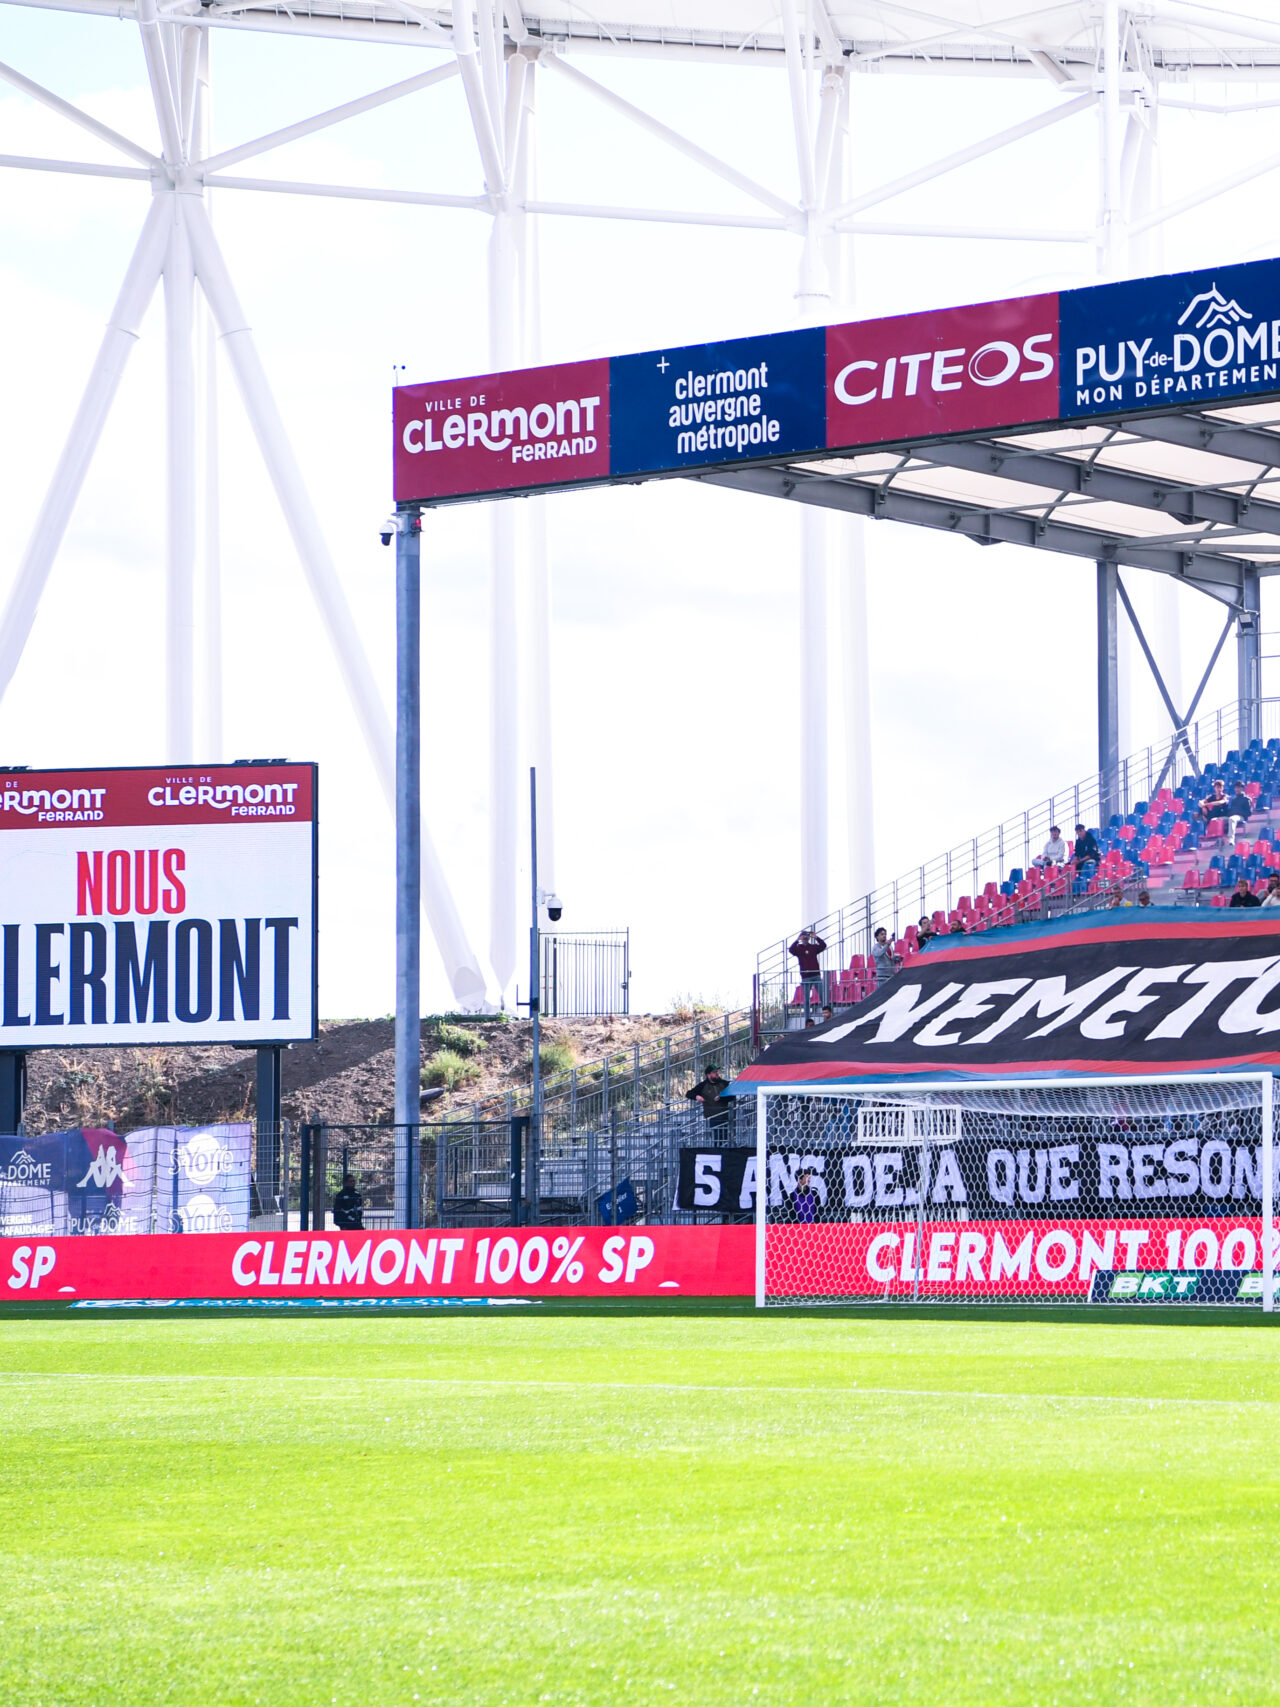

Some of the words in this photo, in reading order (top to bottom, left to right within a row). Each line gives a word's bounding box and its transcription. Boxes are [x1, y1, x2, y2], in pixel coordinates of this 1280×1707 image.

[675, 362, 768, 400] clermont
[833, 333, 1054, 406] CITEOS
[425, 397, 462, 413] VILLE
[470, 395, 487, 407] DE
[668, 393, 761, 428] auvergne
[1076, 384, 1123, 406] MON
[677, 415, 780, 454] métropole
[76, 848, 186, 916] NOUS
[694, 1154, 721, 1206] 5
[739, 1153, 828, 1209] ANS
[842, 1149, 968, 1208] DEJA
[987, 1144, 1080, 1206] QUE
[7, 1245, 57, 1290] SP
[231, 1237, 464, 1287] CLERMONT
[474, 1235, 586, 1284] 100%
[598, 1235, 655, 1284] SP
[866, 1229, 1150, 1282] CLERMONT
[1111, 1276, 1197, 1294] BKT
